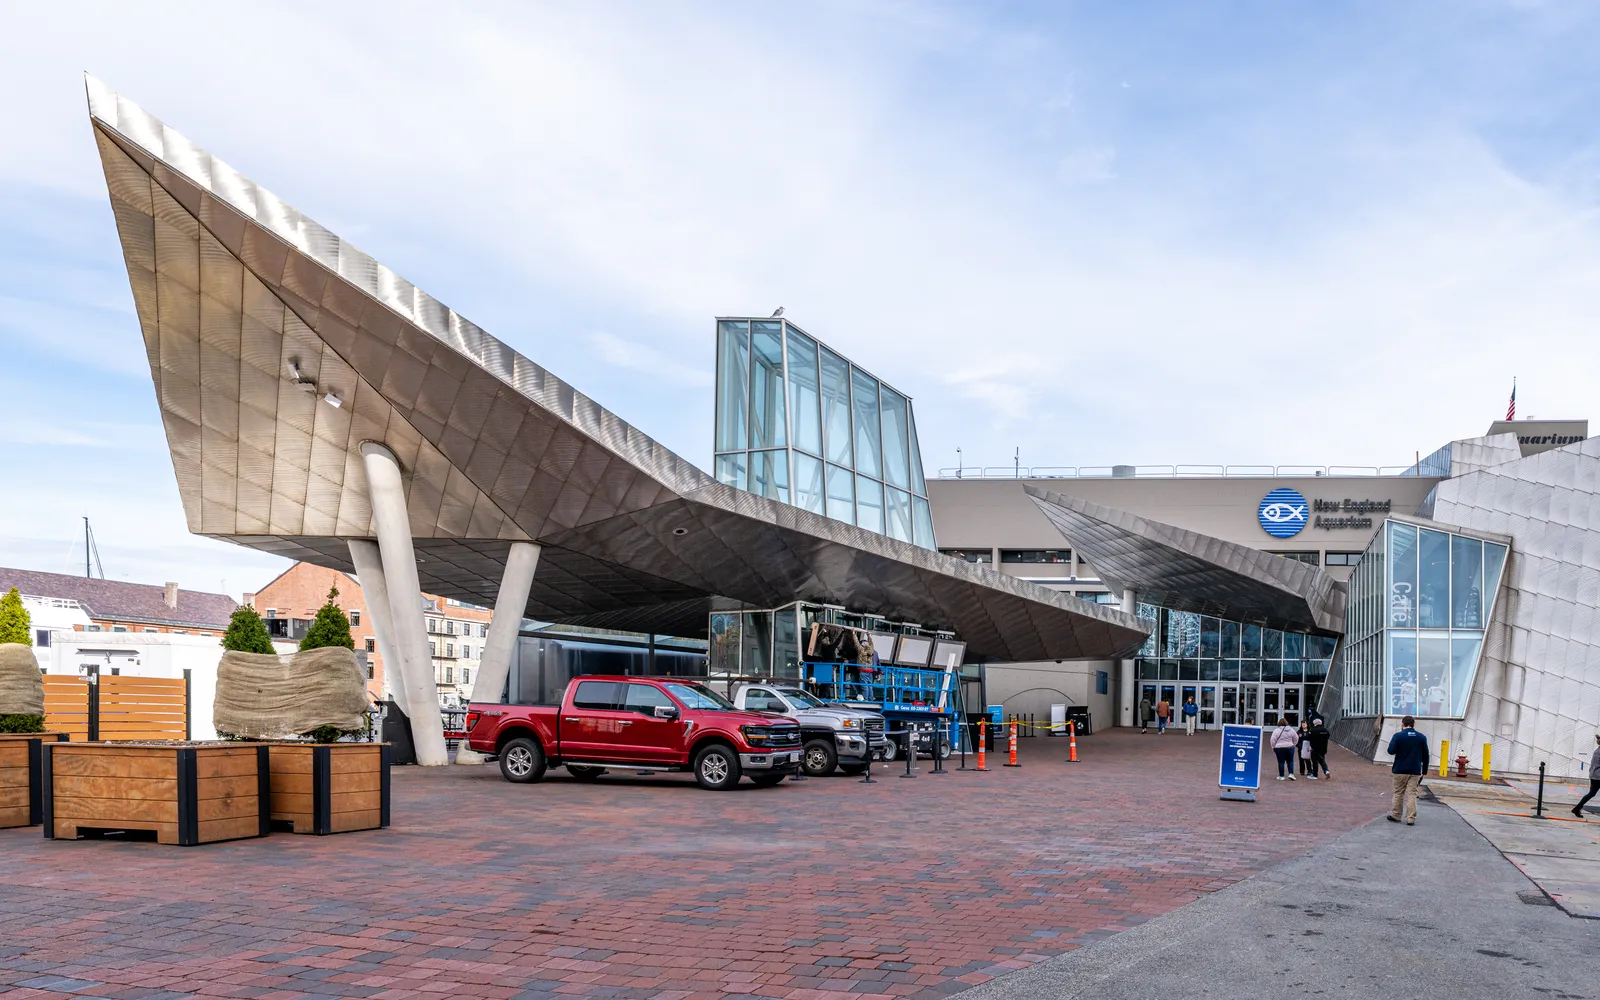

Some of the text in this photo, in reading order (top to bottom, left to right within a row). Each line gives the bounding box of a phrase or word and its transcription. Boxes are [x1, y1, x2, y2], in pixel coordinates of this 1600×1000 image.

[1314, 498, 1392, 515] New England
[1314, 515, 1372, 530] Aquarium
[1392, 581, 1412, 622] Café
